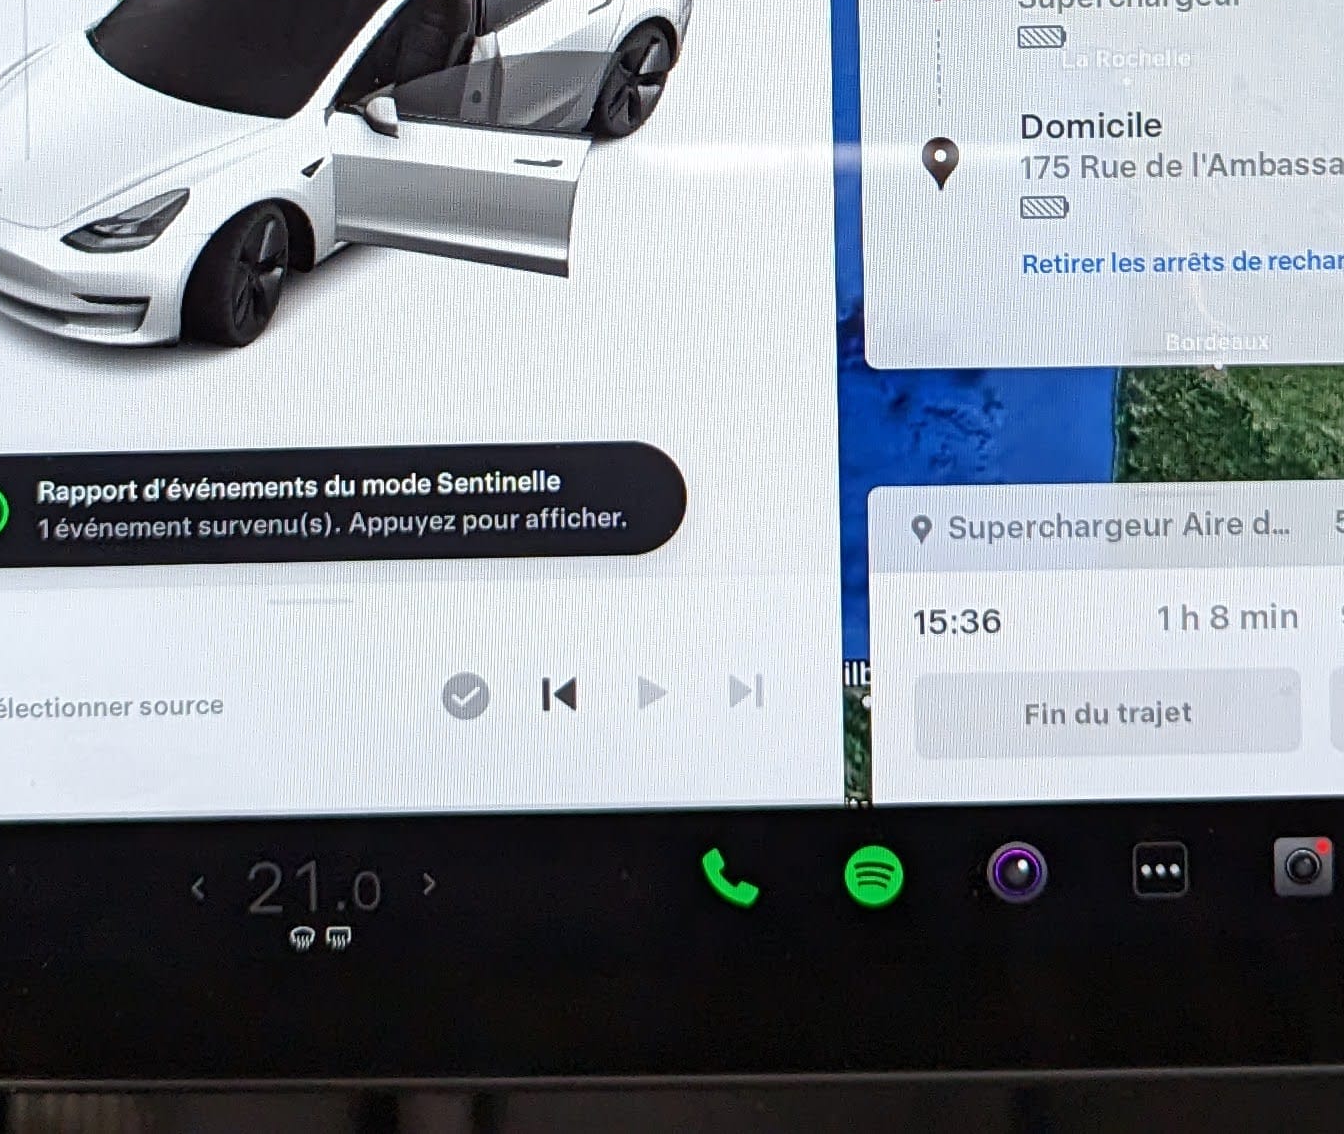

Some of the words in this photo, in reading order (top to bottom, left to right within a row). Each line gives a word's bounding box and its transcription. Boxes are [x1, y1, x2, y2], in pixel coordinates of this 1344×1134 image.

[1020, 111, 1163, 141] Domicile
[1020, 154, 1071, 181] 175
[1080, 153, 1138, 180] Rue
[1145, 152, 1184, 179] de
[1022, 251, 1104, 275] Retirer
[1111, 250, 1146, 275] les
[1152, 249, 1225, 274] arrêts
[1231, 248, 1262, 273] de
[1164, 332, 1270, 353] Bordeaux
[36, 479, 138, 508] Rapport
[142, 476, 319, 502] d'événements
[324, 473, 356, 498] du
[362, 472, 432, 496] mode
[437, 469, 562, 494] Sentinelle
[54, 516, 192, 539] événement
[198, 511, 342, 537] survenu(s).
[348, 510, 457, 537] Appuyez
[462, 512, 521, 536] pour
[525, 506, 628, 529] afficher.
[949, 511, 1173, 545] Superchargeur
[1182, 510, 1245, 538] Aire
[912, 608, 1002, 636] 15:36
[1157, 605, 1170, 632] 1
[1182, 604, 1200, 631] h
[1210, 604, 1230, 631] 8
[1239, 603, 1299, 631] min
[139, 696, 225, 717] source
[1024, 701, 1066, 726] Fin
[1074, 700, 1109, 726] du
[1116, 698, 1194, 732] trajet
[246, 859, 383, 915] 21.0
